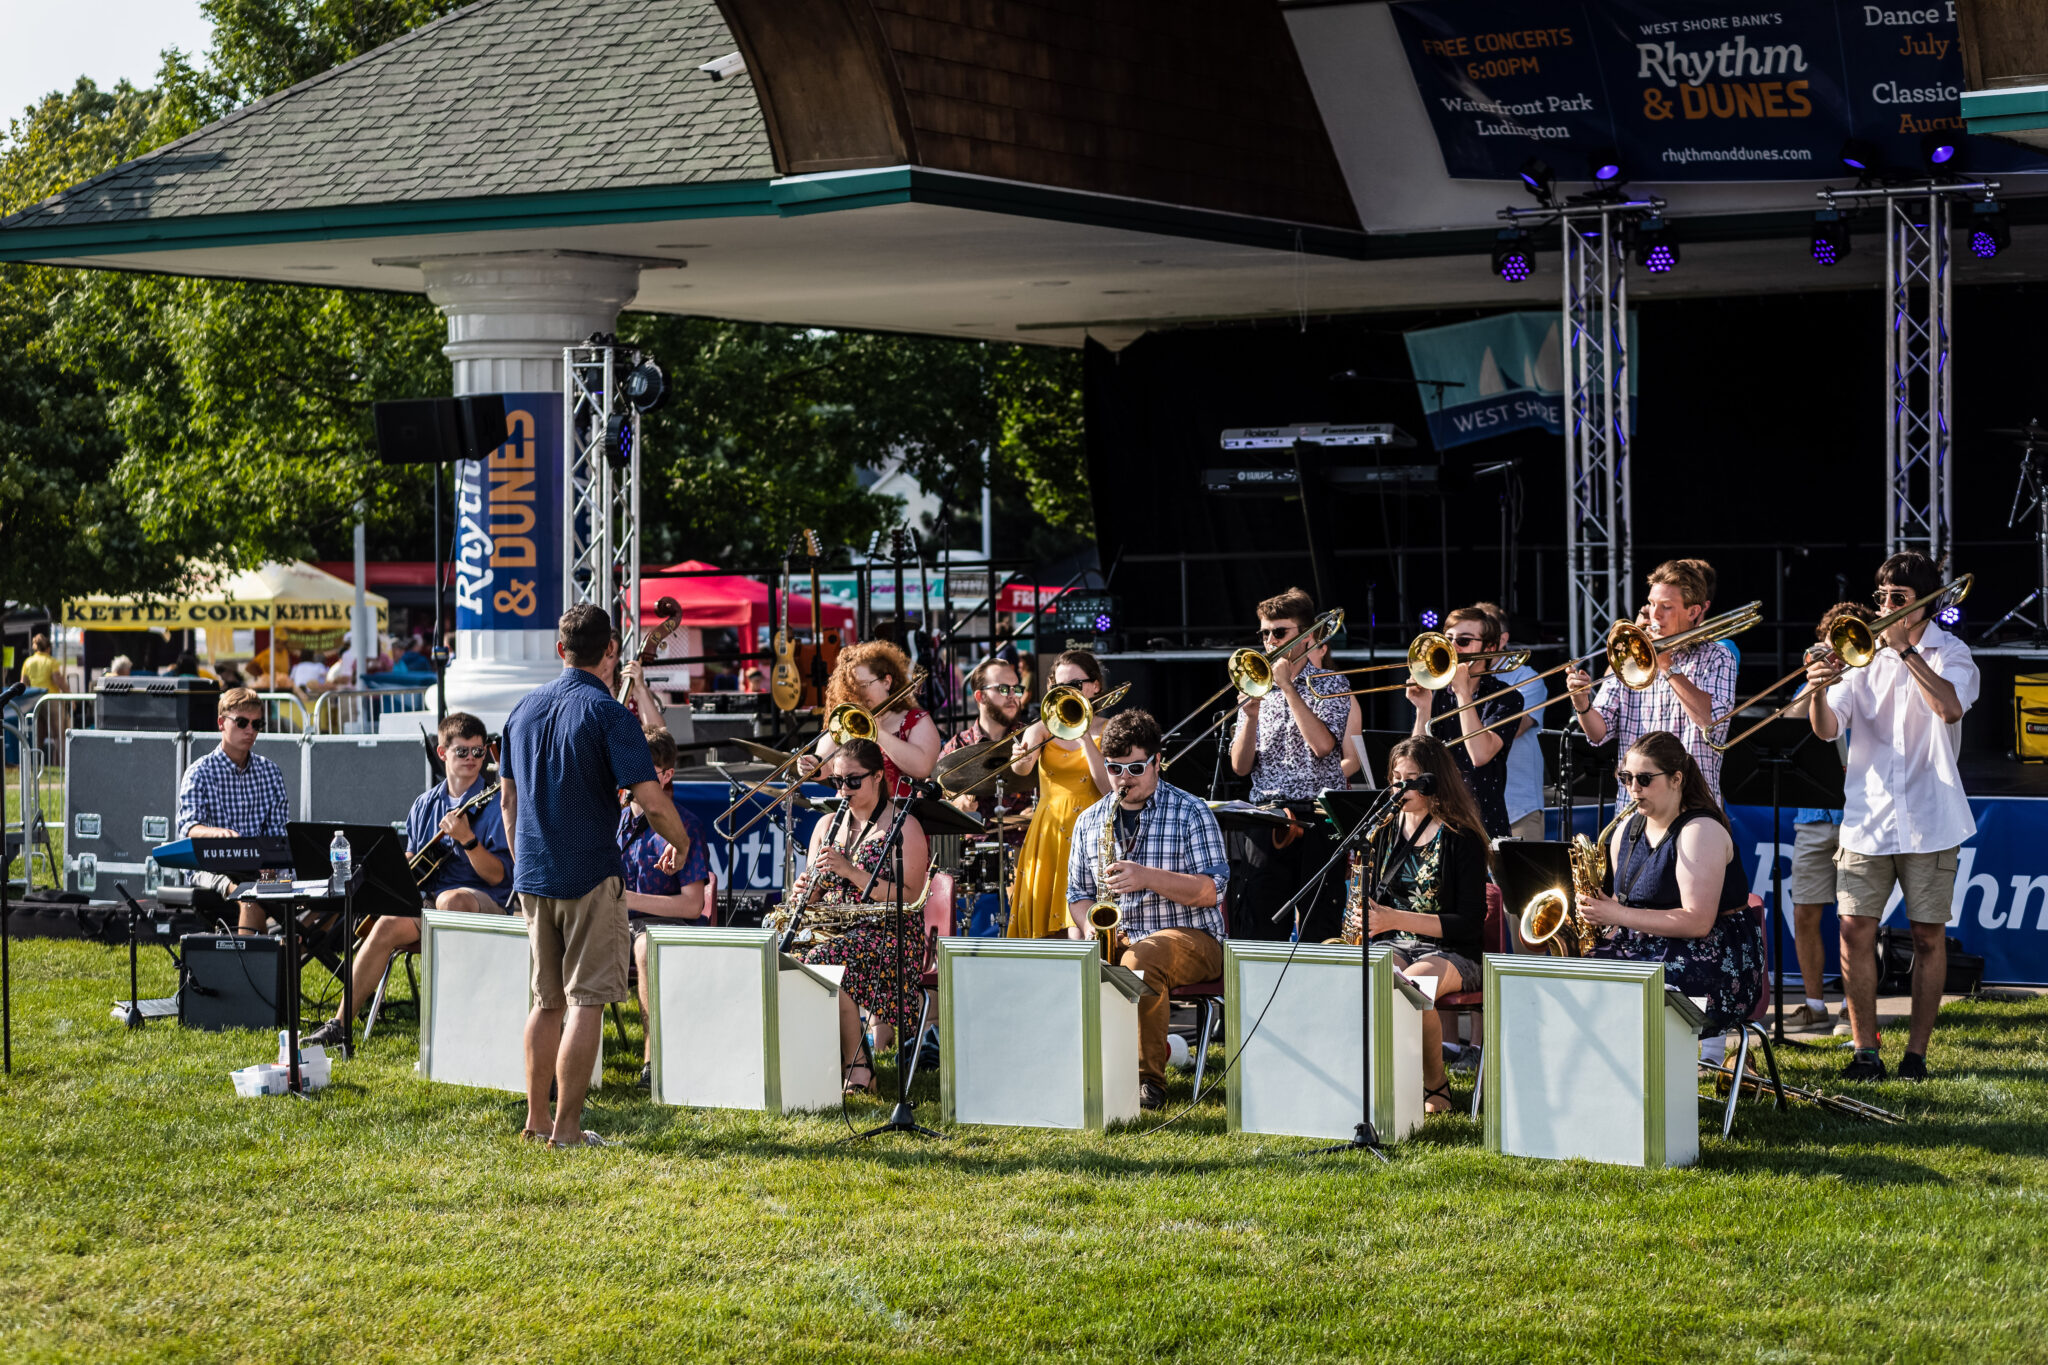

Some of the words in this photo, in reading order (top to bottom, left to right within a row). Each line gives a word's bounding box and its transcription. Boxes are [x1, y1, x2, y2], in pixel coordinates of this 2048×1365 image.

[1640, 21, 1679, 36] WEST
[1682, 17, 1729, 32] SHORE
[1732, 13, 1783, 28] BANK'S
[1864, 5, 1940, 26] Dance
[1422, 37, 1471, 57] FREE
[1475, 28, 1573, 53] CONCERTS
[1900, 32, 1950, 60] July
[1468, 56, 1540, 79] 6:00PM
[1636, 35, 1808, 87] Rhythm
[1643, 87, 1674, 120] &
[1679, 80, 1812, 120] DUNES
[1872, 81, 1958, 104] Classic
[1441, 97, 1544, 116] Waterfront
[1547, 93, 1594, 113] Park
[1475, 120, 1570, 141] Ludington
[1899, 113, 1968, 134] Augu
[1662, 146, 1811, 164] rhythmanddunes.com
[1453, 404, 1509, 433] WEST
[1515, 401, 1560, 424] SHRE
[1243, 427, 1279, 438] Roland
[488, 409, 537, 568] DUNES
[456, 459, 494, 615] Rhyth
[493, 579, 537, 617] &
[67, 604, 181, 622] KETTLE
[188, 604, 270, 622] CORN
[276, 604, 342, 621] KETTLE
[203, 848, 261, 859] KURZWEIL
